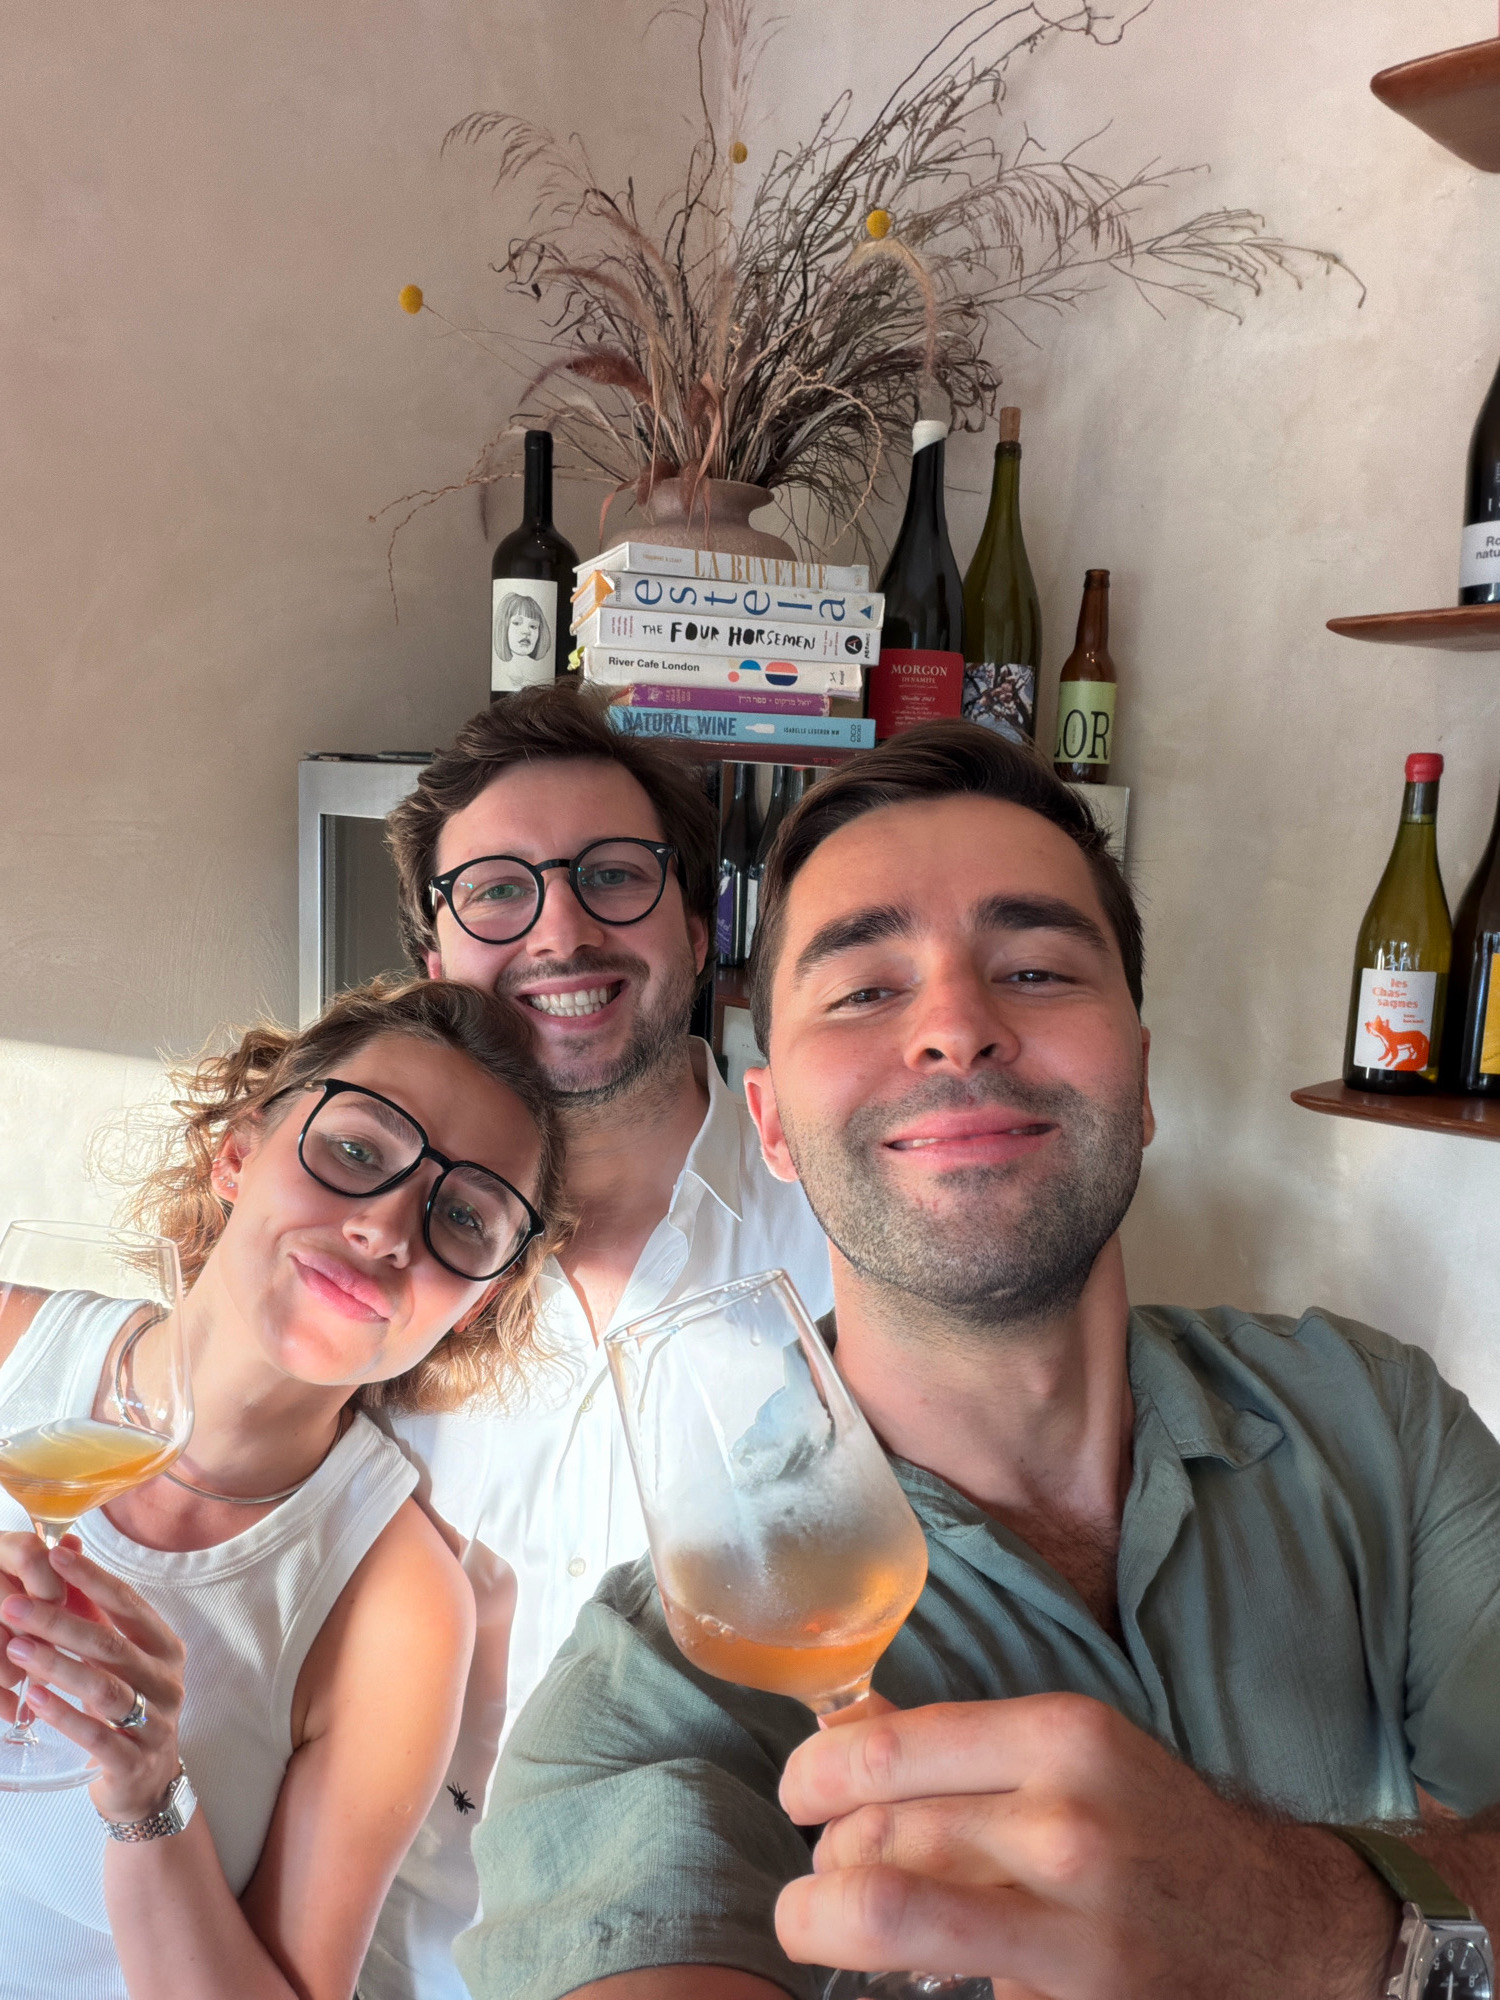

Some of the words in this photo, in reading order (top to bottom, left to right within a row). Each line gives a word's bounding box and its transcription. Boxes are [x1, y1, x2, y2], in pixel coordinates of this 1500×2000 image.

[694, 549, 720, 580] LA
[730, 554, 829, 590] BUVETTE
[634, 578, 846, 622] estela
[642, 625, 663, 635] THE
[670, 622, 720, 643] FOUR
[728, 626, 816, 650] HORSEMEN
[608, 656, 635, 667] River
[637, 659, 660, 669] Cafe
[662, 661, 701, 672] London
[891, 664, 948, 676] MORGON
[622, 711, 692, 735] NATURAL
[698, 715, 737, 736] WINE
[1054, 709, 1110, 760] OR
[1372, 986, 1408, 998] Chas-
[1390, 978, 1408, 988] les
[1377, 998, 1419, 1009] sagnes
